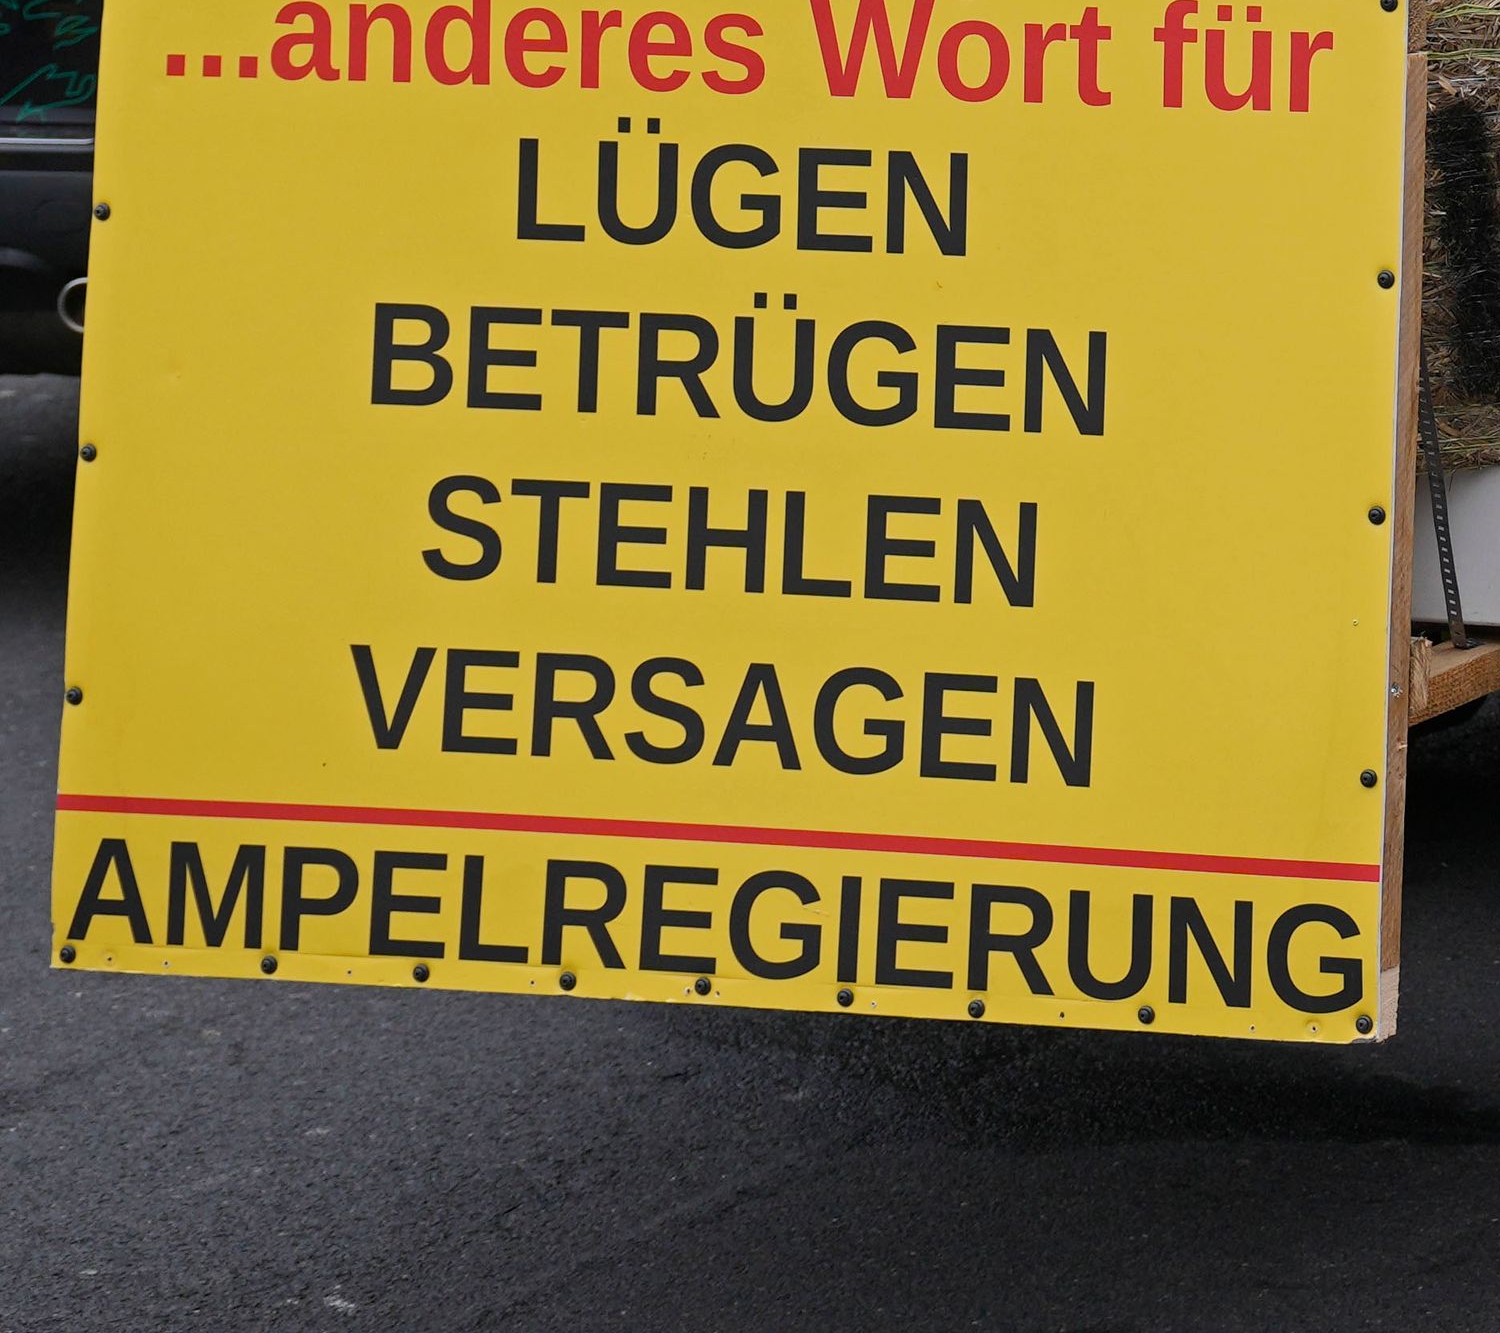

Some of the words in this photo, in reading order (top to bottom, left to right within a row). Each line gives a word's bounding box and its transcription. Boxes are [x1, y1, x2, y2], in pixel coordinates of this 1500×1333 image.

[516, 117, 969, 257] LÜGEN
[370, 291, 1107, 437] BETRÜGEN
[421, 474, 1038, 608] STEHLEN
[349, 644, 1095, 788] VERSAGEN
[68, 836, 1365, 1016] AMPELREGIERUNG
